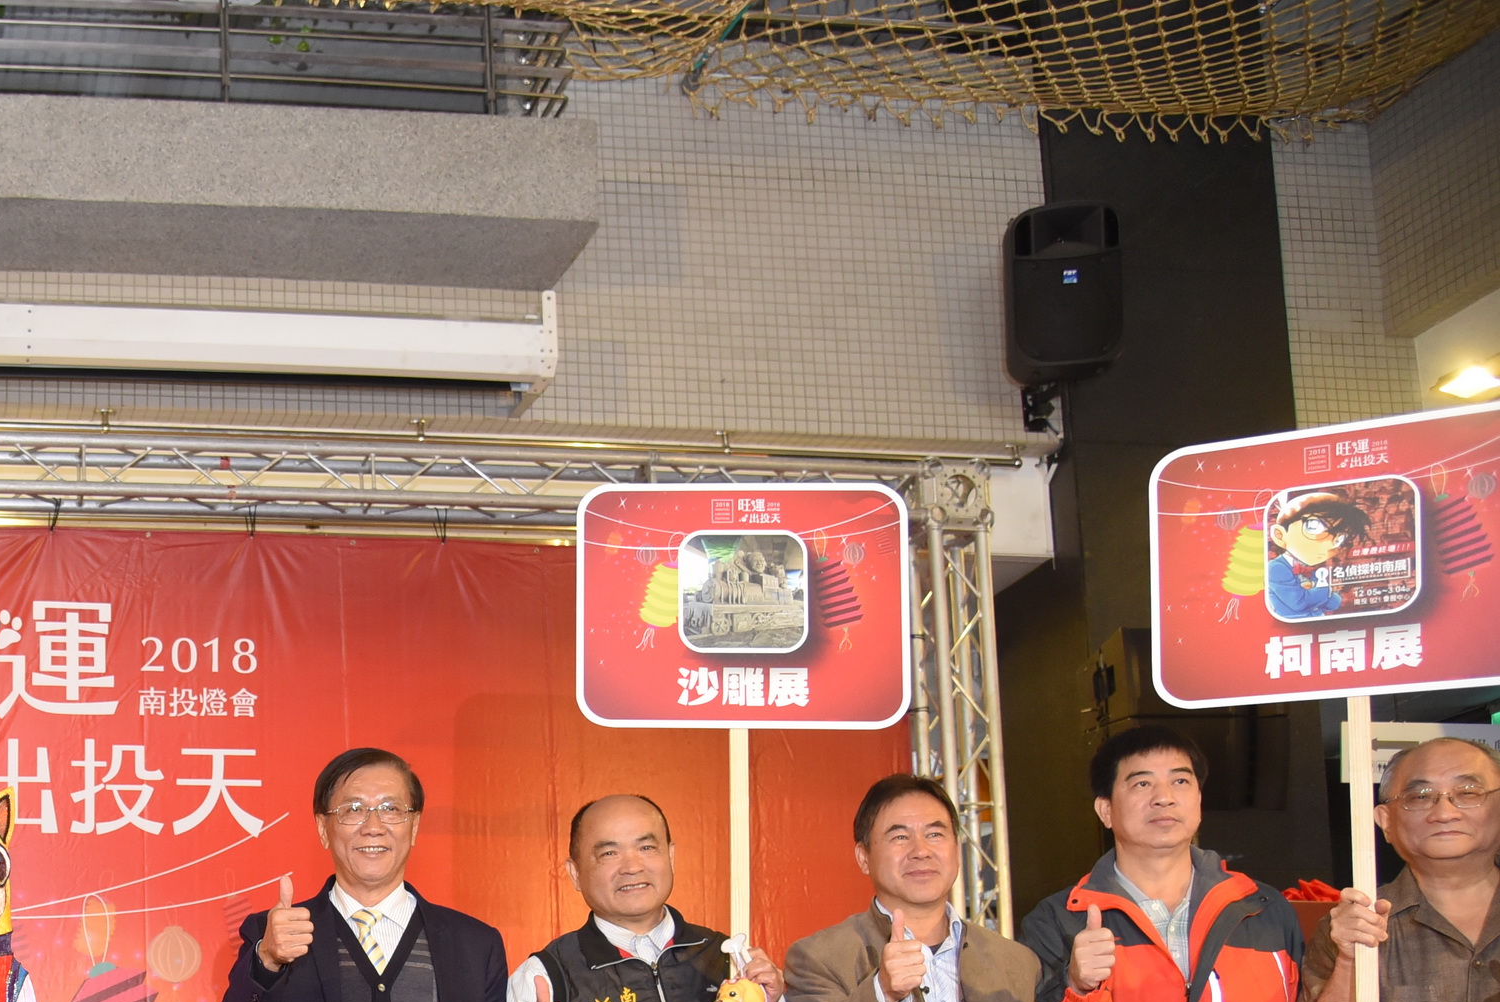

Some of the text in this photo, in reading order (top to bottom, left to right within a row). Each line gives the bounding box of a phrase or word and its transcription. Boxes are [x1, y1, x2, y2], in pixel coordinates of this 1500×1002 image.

[1333, 559, 1407, 578] 名偵探柯南展
[140, 637, 257, 673] 2018
[1264, 624, 1422, 679] 柯南展
[138, 687, 258, 718] 南投燈會
[677, 667, 810, 707] 沙雕展
